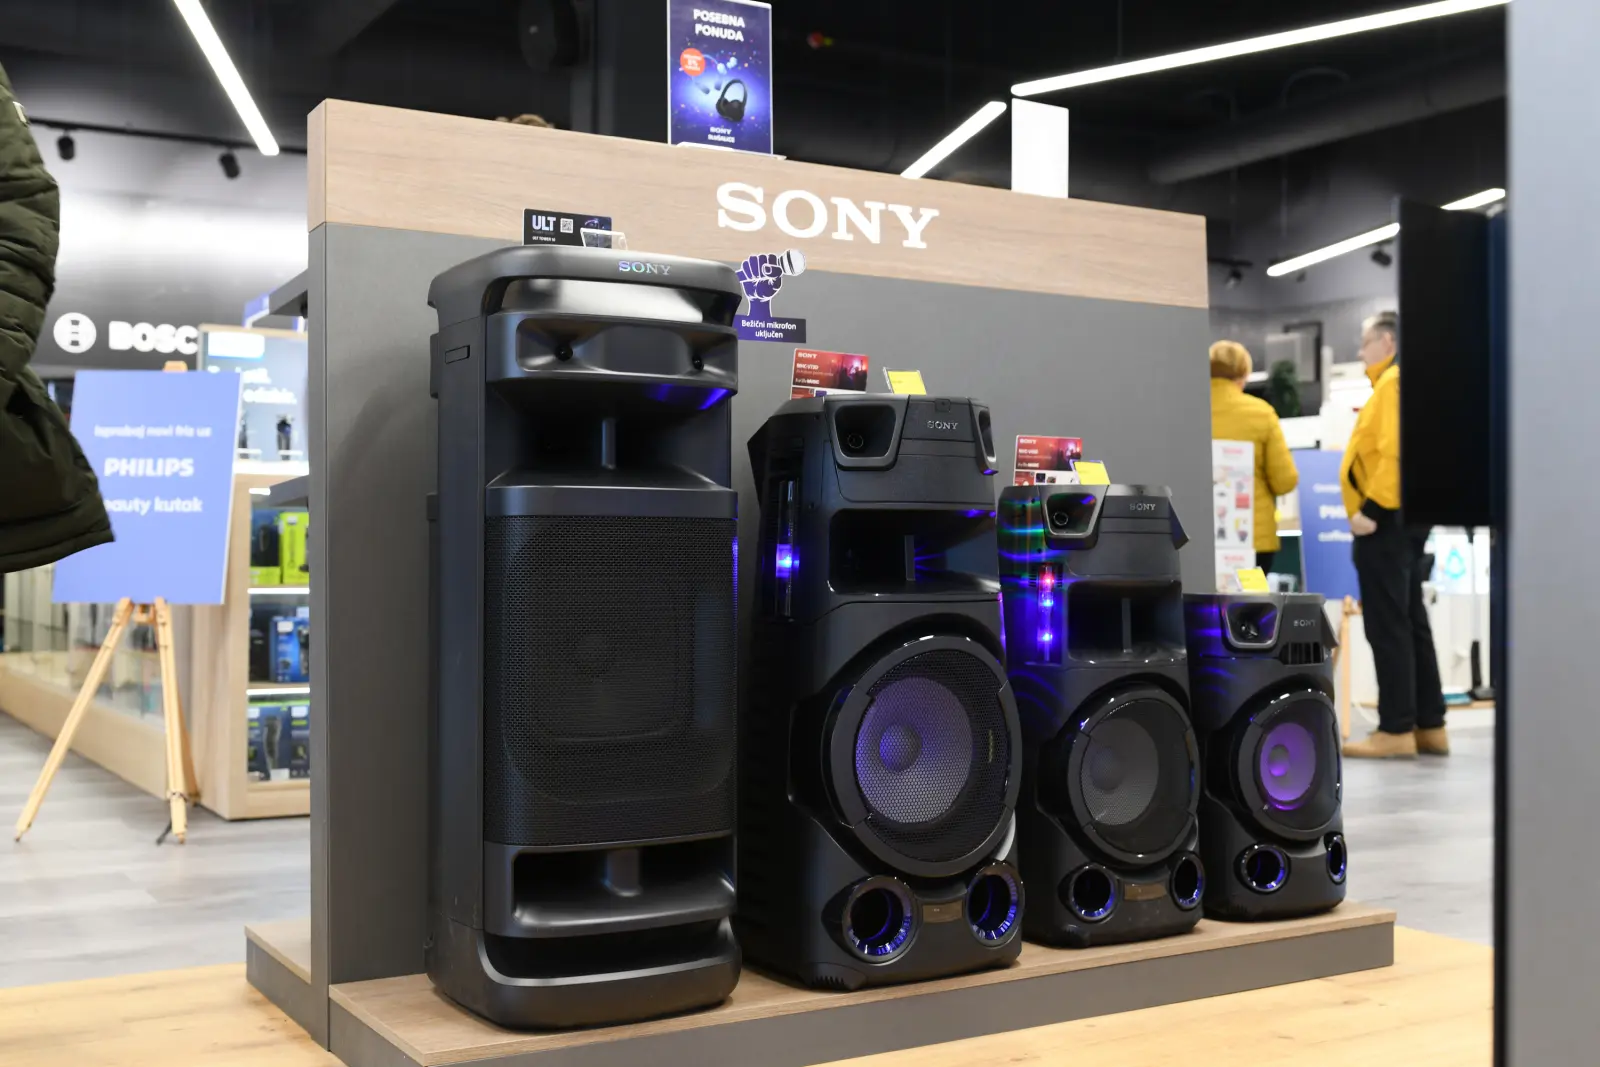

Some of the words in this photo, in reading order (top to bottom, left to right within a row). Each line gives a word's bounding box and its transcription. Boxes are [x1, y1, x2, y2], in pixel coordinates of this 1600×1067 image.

[693, 8, 746, 28] POSEBNA
[695, 23, 744, 42] PONUDA
[709, 126, 732, 135] SONY
[532, 214, 557, 232] ULT
[716, 182, 940, 249] SONY
[618, 260, 671, 276] SONY
[741, 319, 766, 329] Bežični
[766, 321, 797, 331] mikrofon
[108, 320, 199, 355] BOSC
[755, 329, 784, 340] uključen
[798, 351, 818, 359] SONY
[926, 419, 959, 430] SONY
[103, 457, 194, 477] PHILIPS
[1129, 503, 1156, 512] SONY
